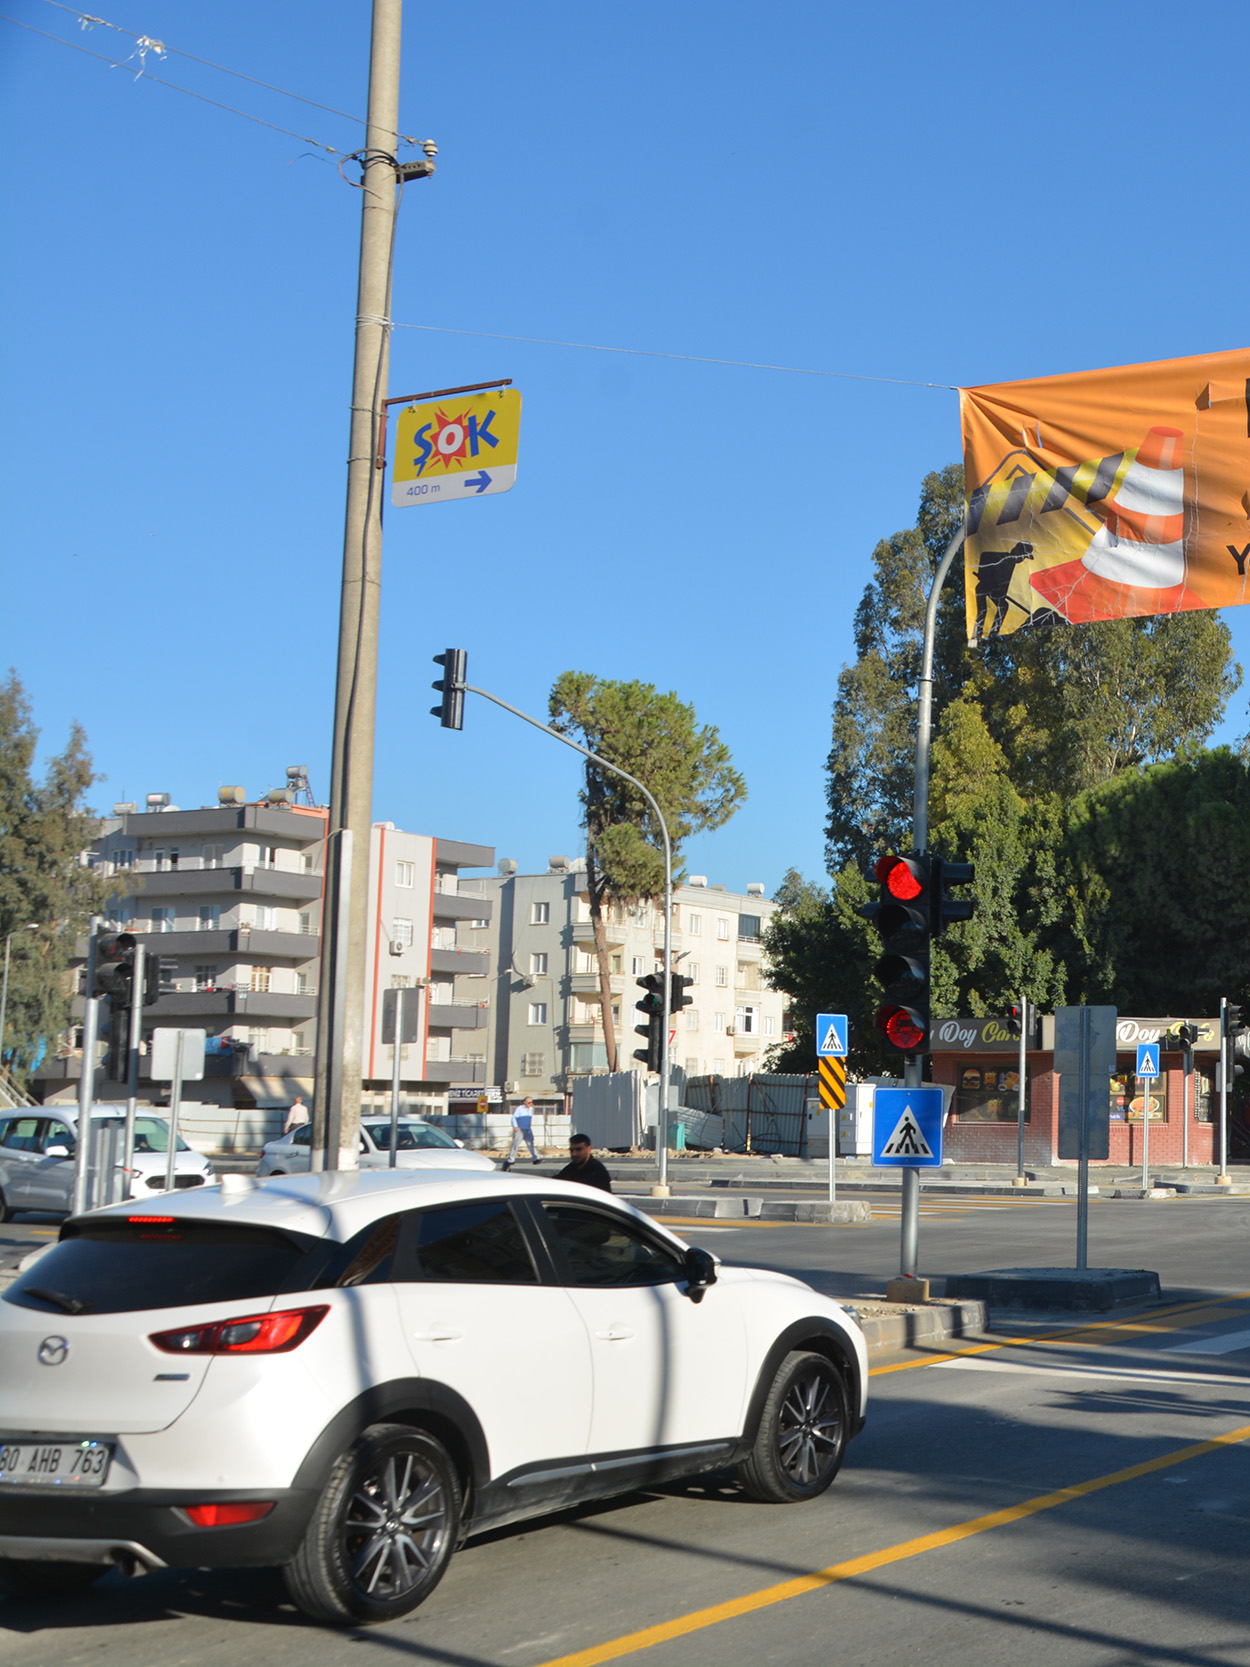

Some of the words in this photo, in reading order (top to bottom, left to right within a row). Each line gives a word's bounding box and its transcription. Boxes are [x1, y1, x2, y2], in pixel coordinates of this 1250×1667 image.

[413, 409, 500, 477] ŞOK
[407, 484, 428, 497] 400
[431, 485, 440, 493] m
[939, 1020, 977, 1048] Doy
[1116, 1020, 1160, 1044] Doy
[0, 1448, 20, 1472] 80
[28, 1448, 62, 1473] AHB
[70, 1449, 105, 1474] 763
